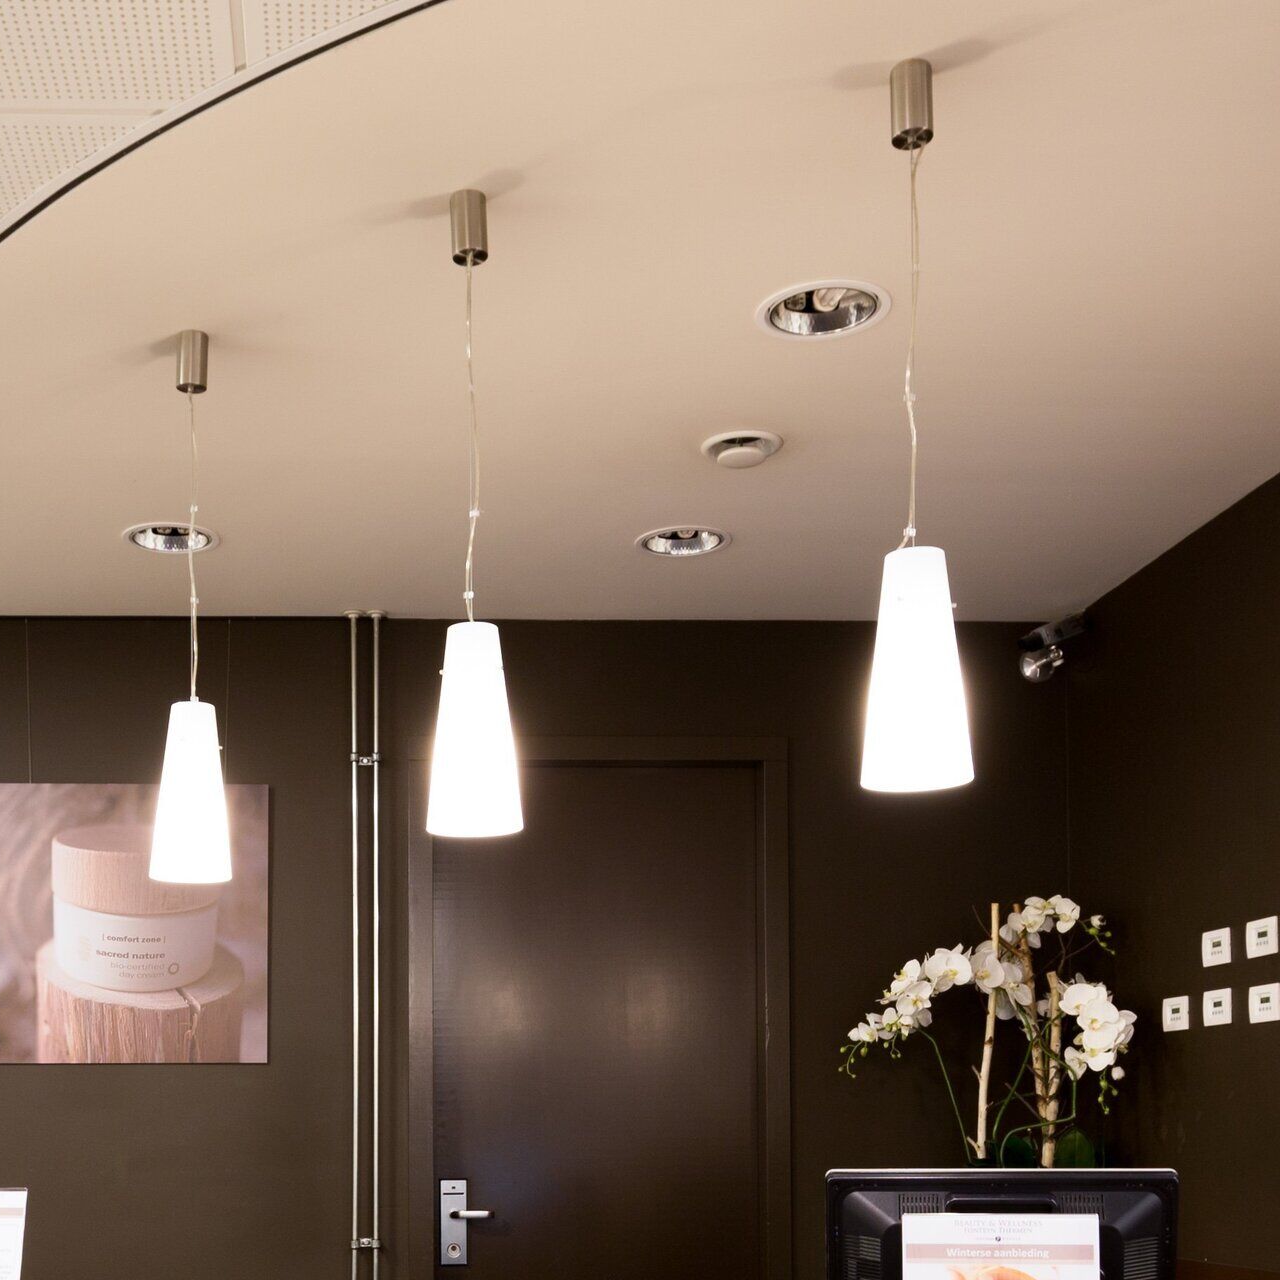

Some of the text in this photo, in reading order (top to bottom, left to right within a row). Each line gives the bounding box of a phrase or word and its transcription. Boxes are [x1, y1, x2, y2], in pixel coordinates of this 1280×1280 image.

[106, 935, 139, 943] comfort
[96, 950, 165, 960] sacred nature
[946, 1248, 1049, 1259] Winterse aanbieding
